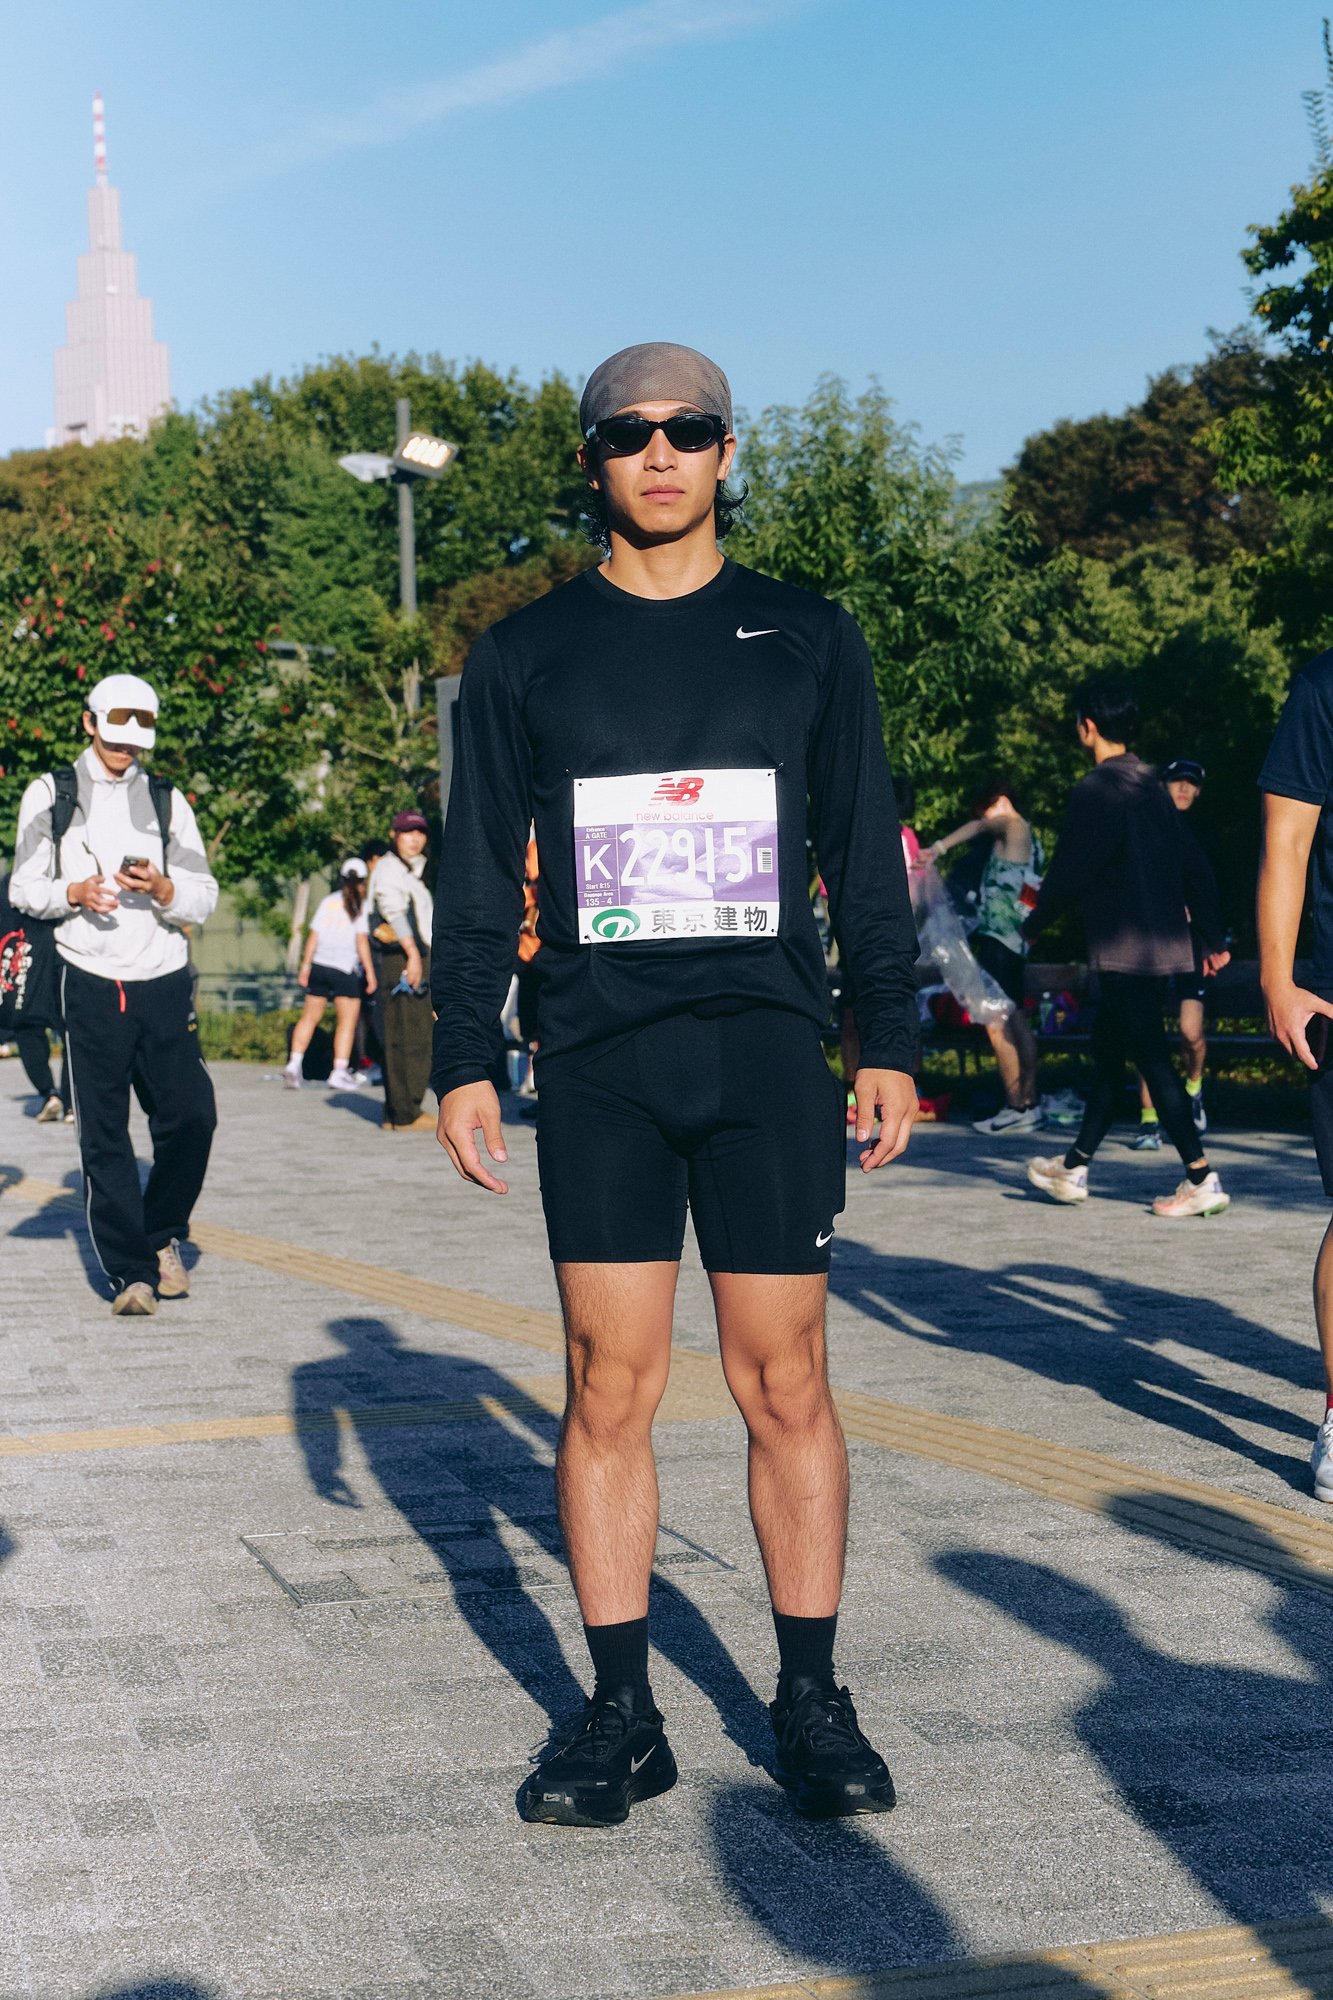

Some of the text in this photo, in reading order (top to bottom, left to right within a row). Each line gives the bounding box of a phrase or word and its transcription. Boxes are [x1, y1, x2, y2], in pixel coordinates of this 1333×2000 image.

[636, 809, 715, 822] new balance
[591, 831, 608, 839] GATE
[583, 843, 614, 882] K
[619, 827, 748, 887] 22915
[651, 905, 768, 934] 東京建物
